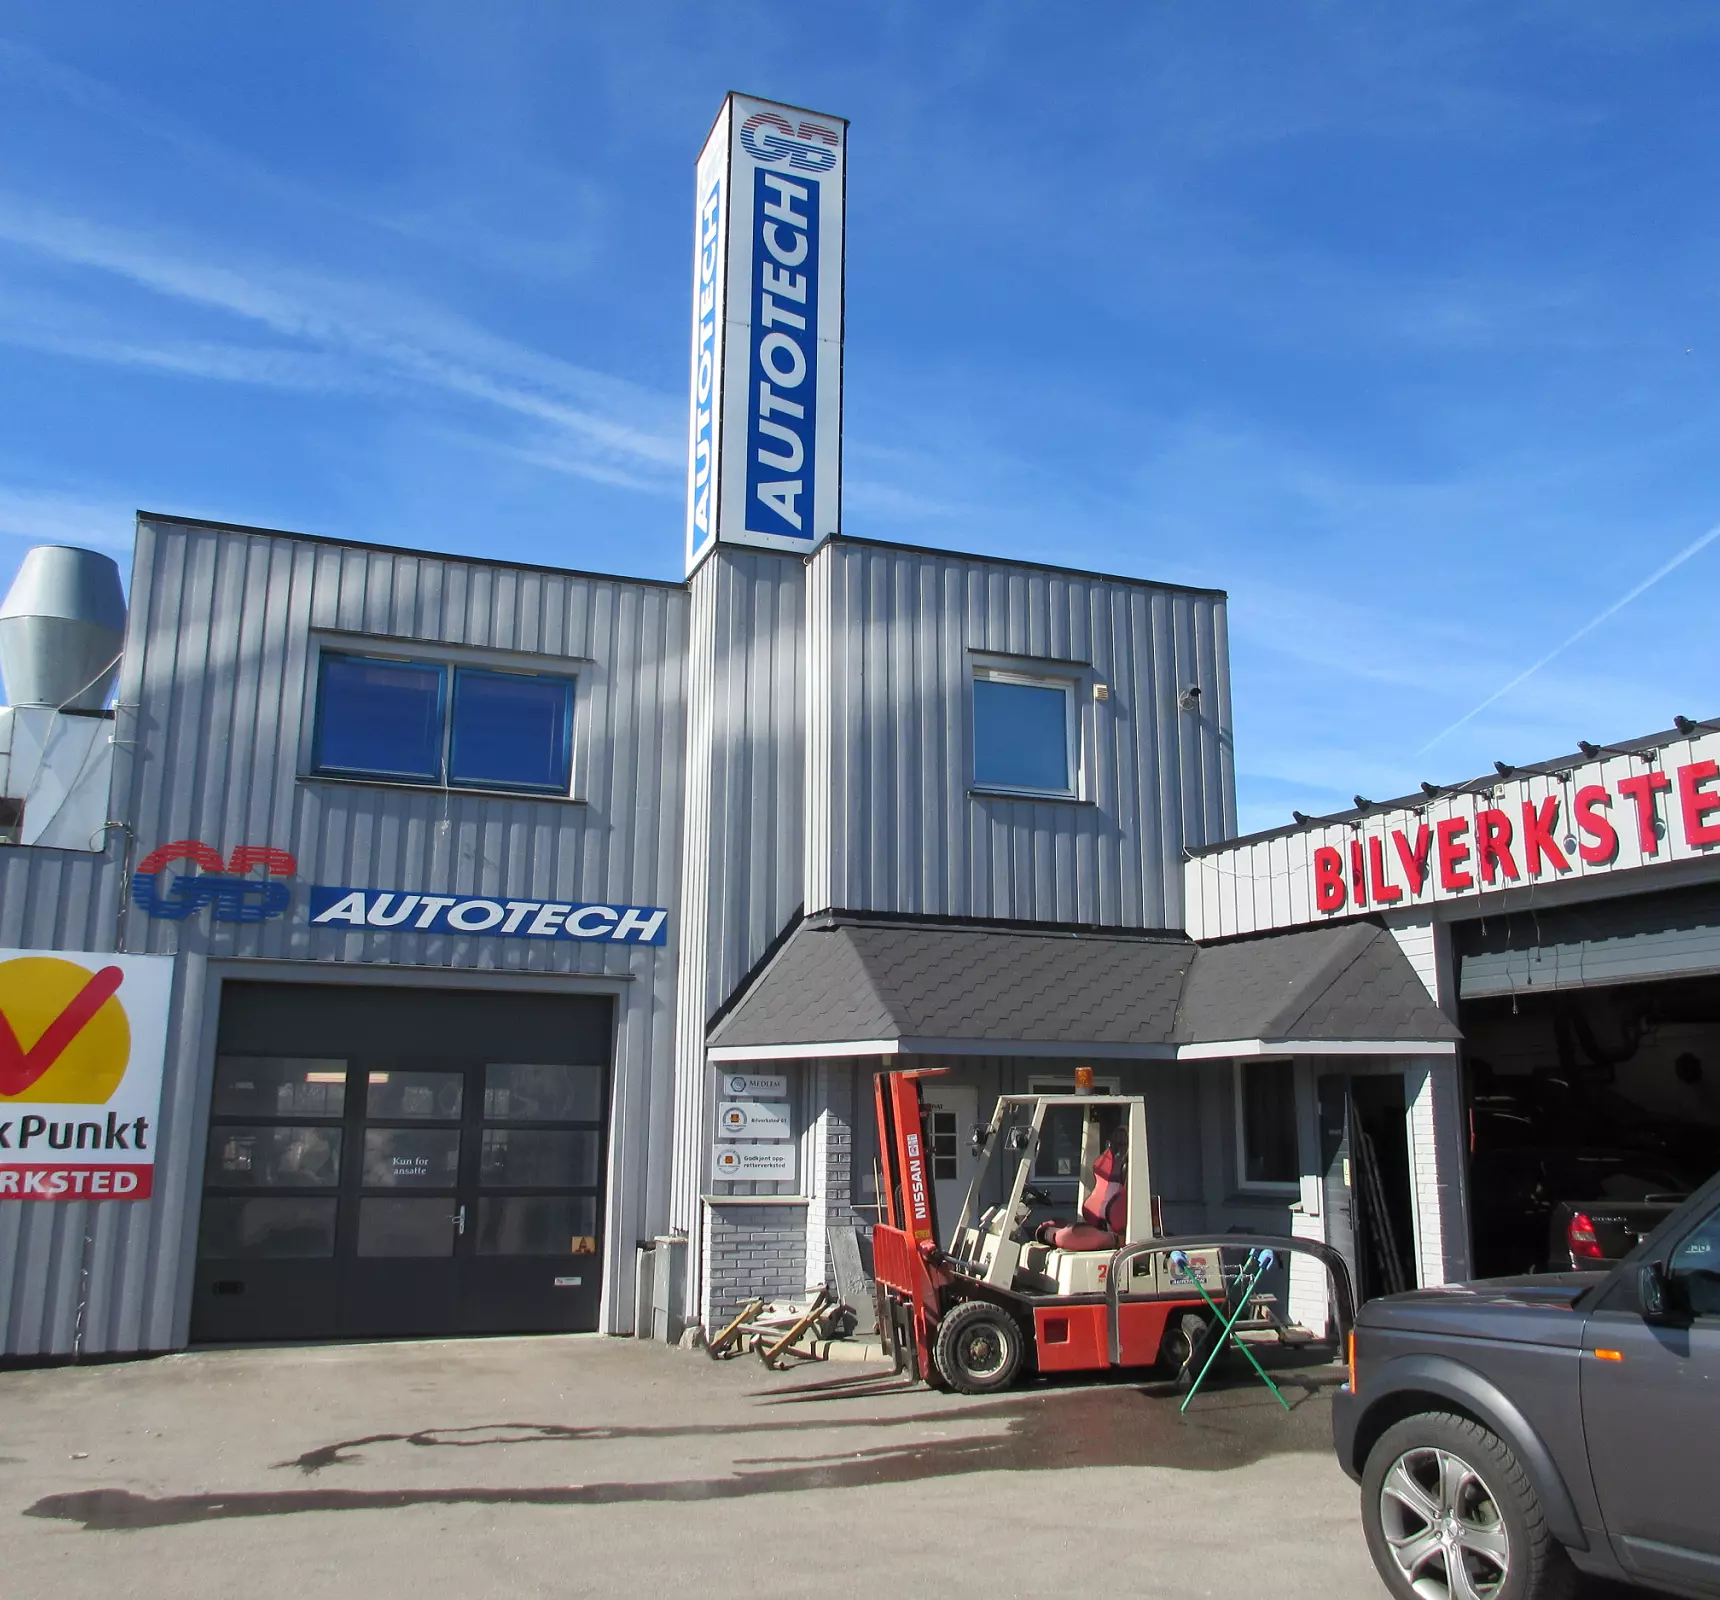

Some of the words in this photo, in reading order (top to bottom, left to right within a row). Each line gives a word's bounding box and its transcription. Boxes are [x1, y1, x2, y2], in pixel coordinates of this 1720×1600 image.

[695, 192, 718, 534] AUTOTECH
[757, 172, 809, 531] AUTOTECH
[312, 892, 668, 942] AUTOTECH
[0, 1171, 139, 1193] RKSTED
[393, 1157, 412, 1165] Kun
[415, 1157, 429, 1165] for
[393, 1167, 427, 1175] ansatte
[910, 1160, 926, 1219] NISSAN
